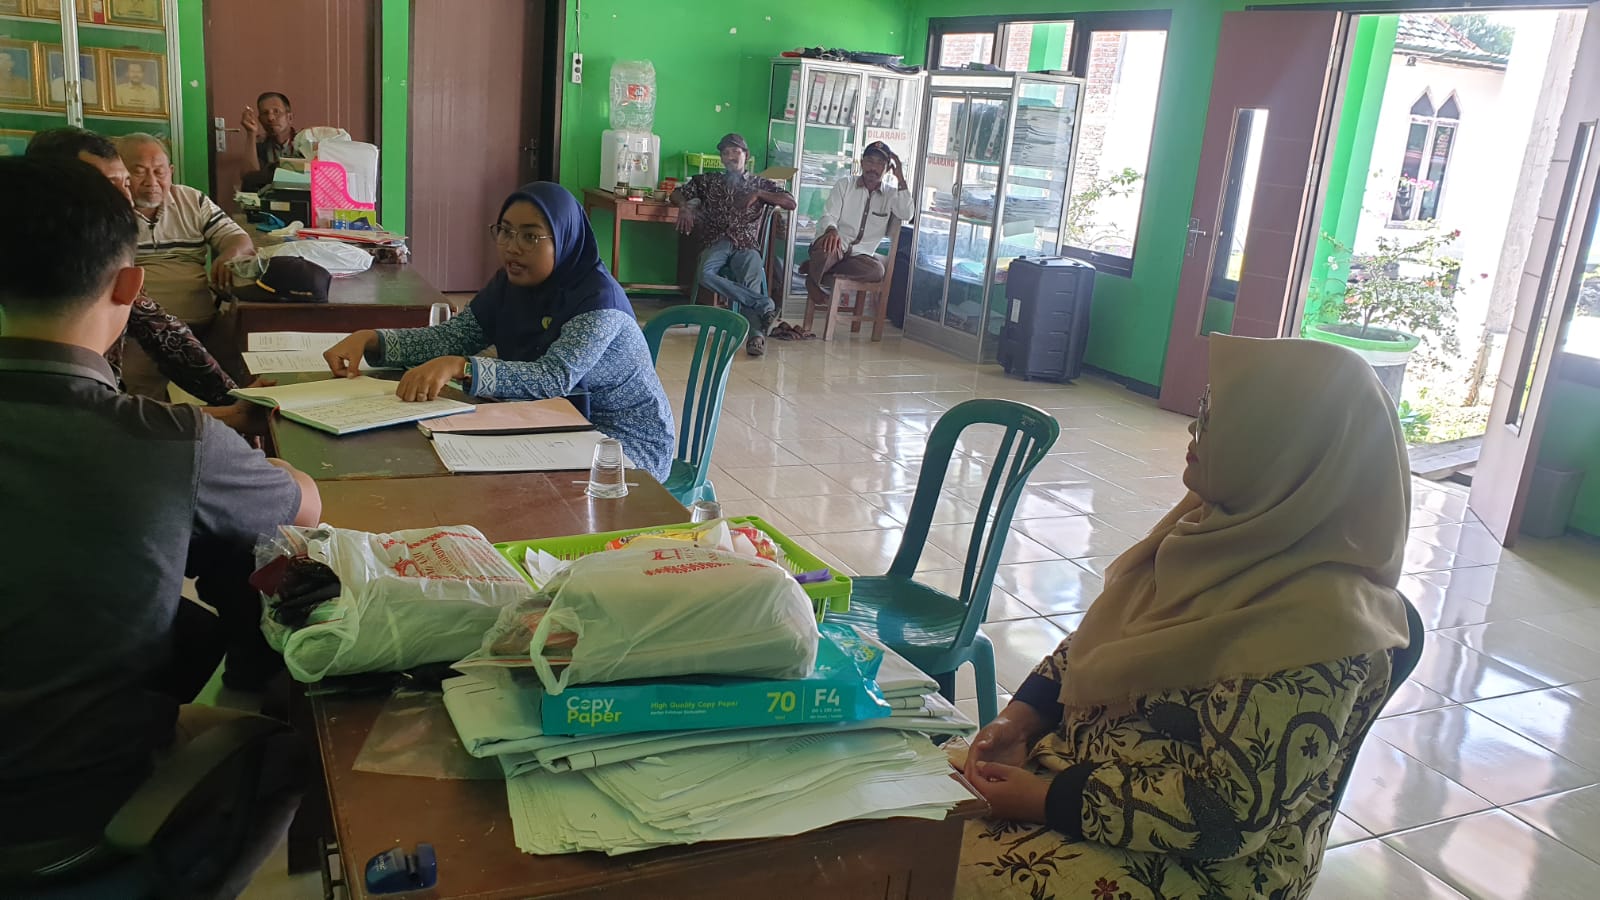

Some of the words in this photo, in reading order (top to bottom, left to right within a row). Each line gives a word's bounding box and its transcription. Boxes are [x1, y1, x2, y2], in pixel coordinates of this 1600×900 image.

[867, 130, 906, 140] DILARANG
[566, 696, 614, 713] Copy
[651, 702, 667, 710] High
[670, 701, 695, 709] Quality
[697, 701, 716, 709] Copy
[718, 700, 738, 708] Paper
[767, 691, 796, 713] 70
[814, 688, 840, 707] F4
[567, 710, 622, 727] Paper
